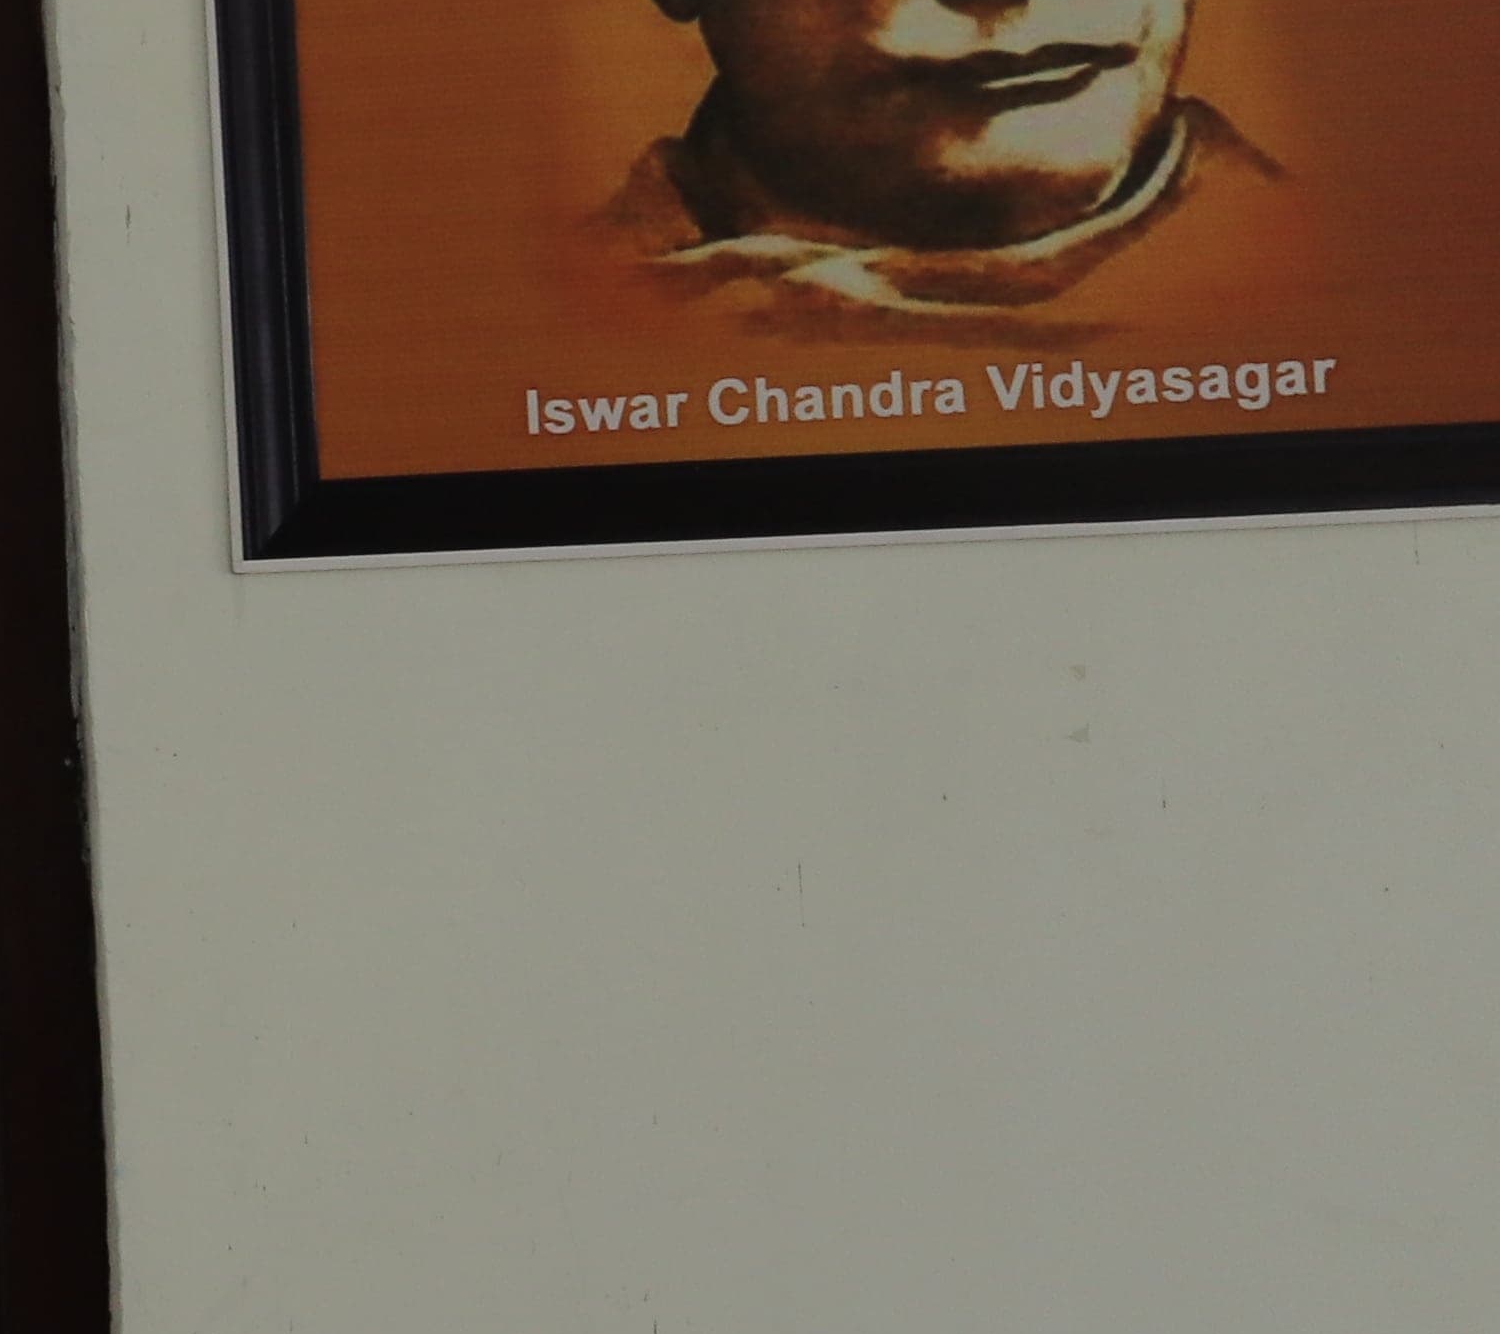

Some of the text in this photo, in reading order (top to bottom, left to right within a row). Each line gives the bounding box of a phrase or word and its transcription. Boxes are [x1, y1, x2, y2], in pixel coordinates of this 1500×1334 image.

[526, 357, 1337, 435] Iswar Chandra Vidyasagar
